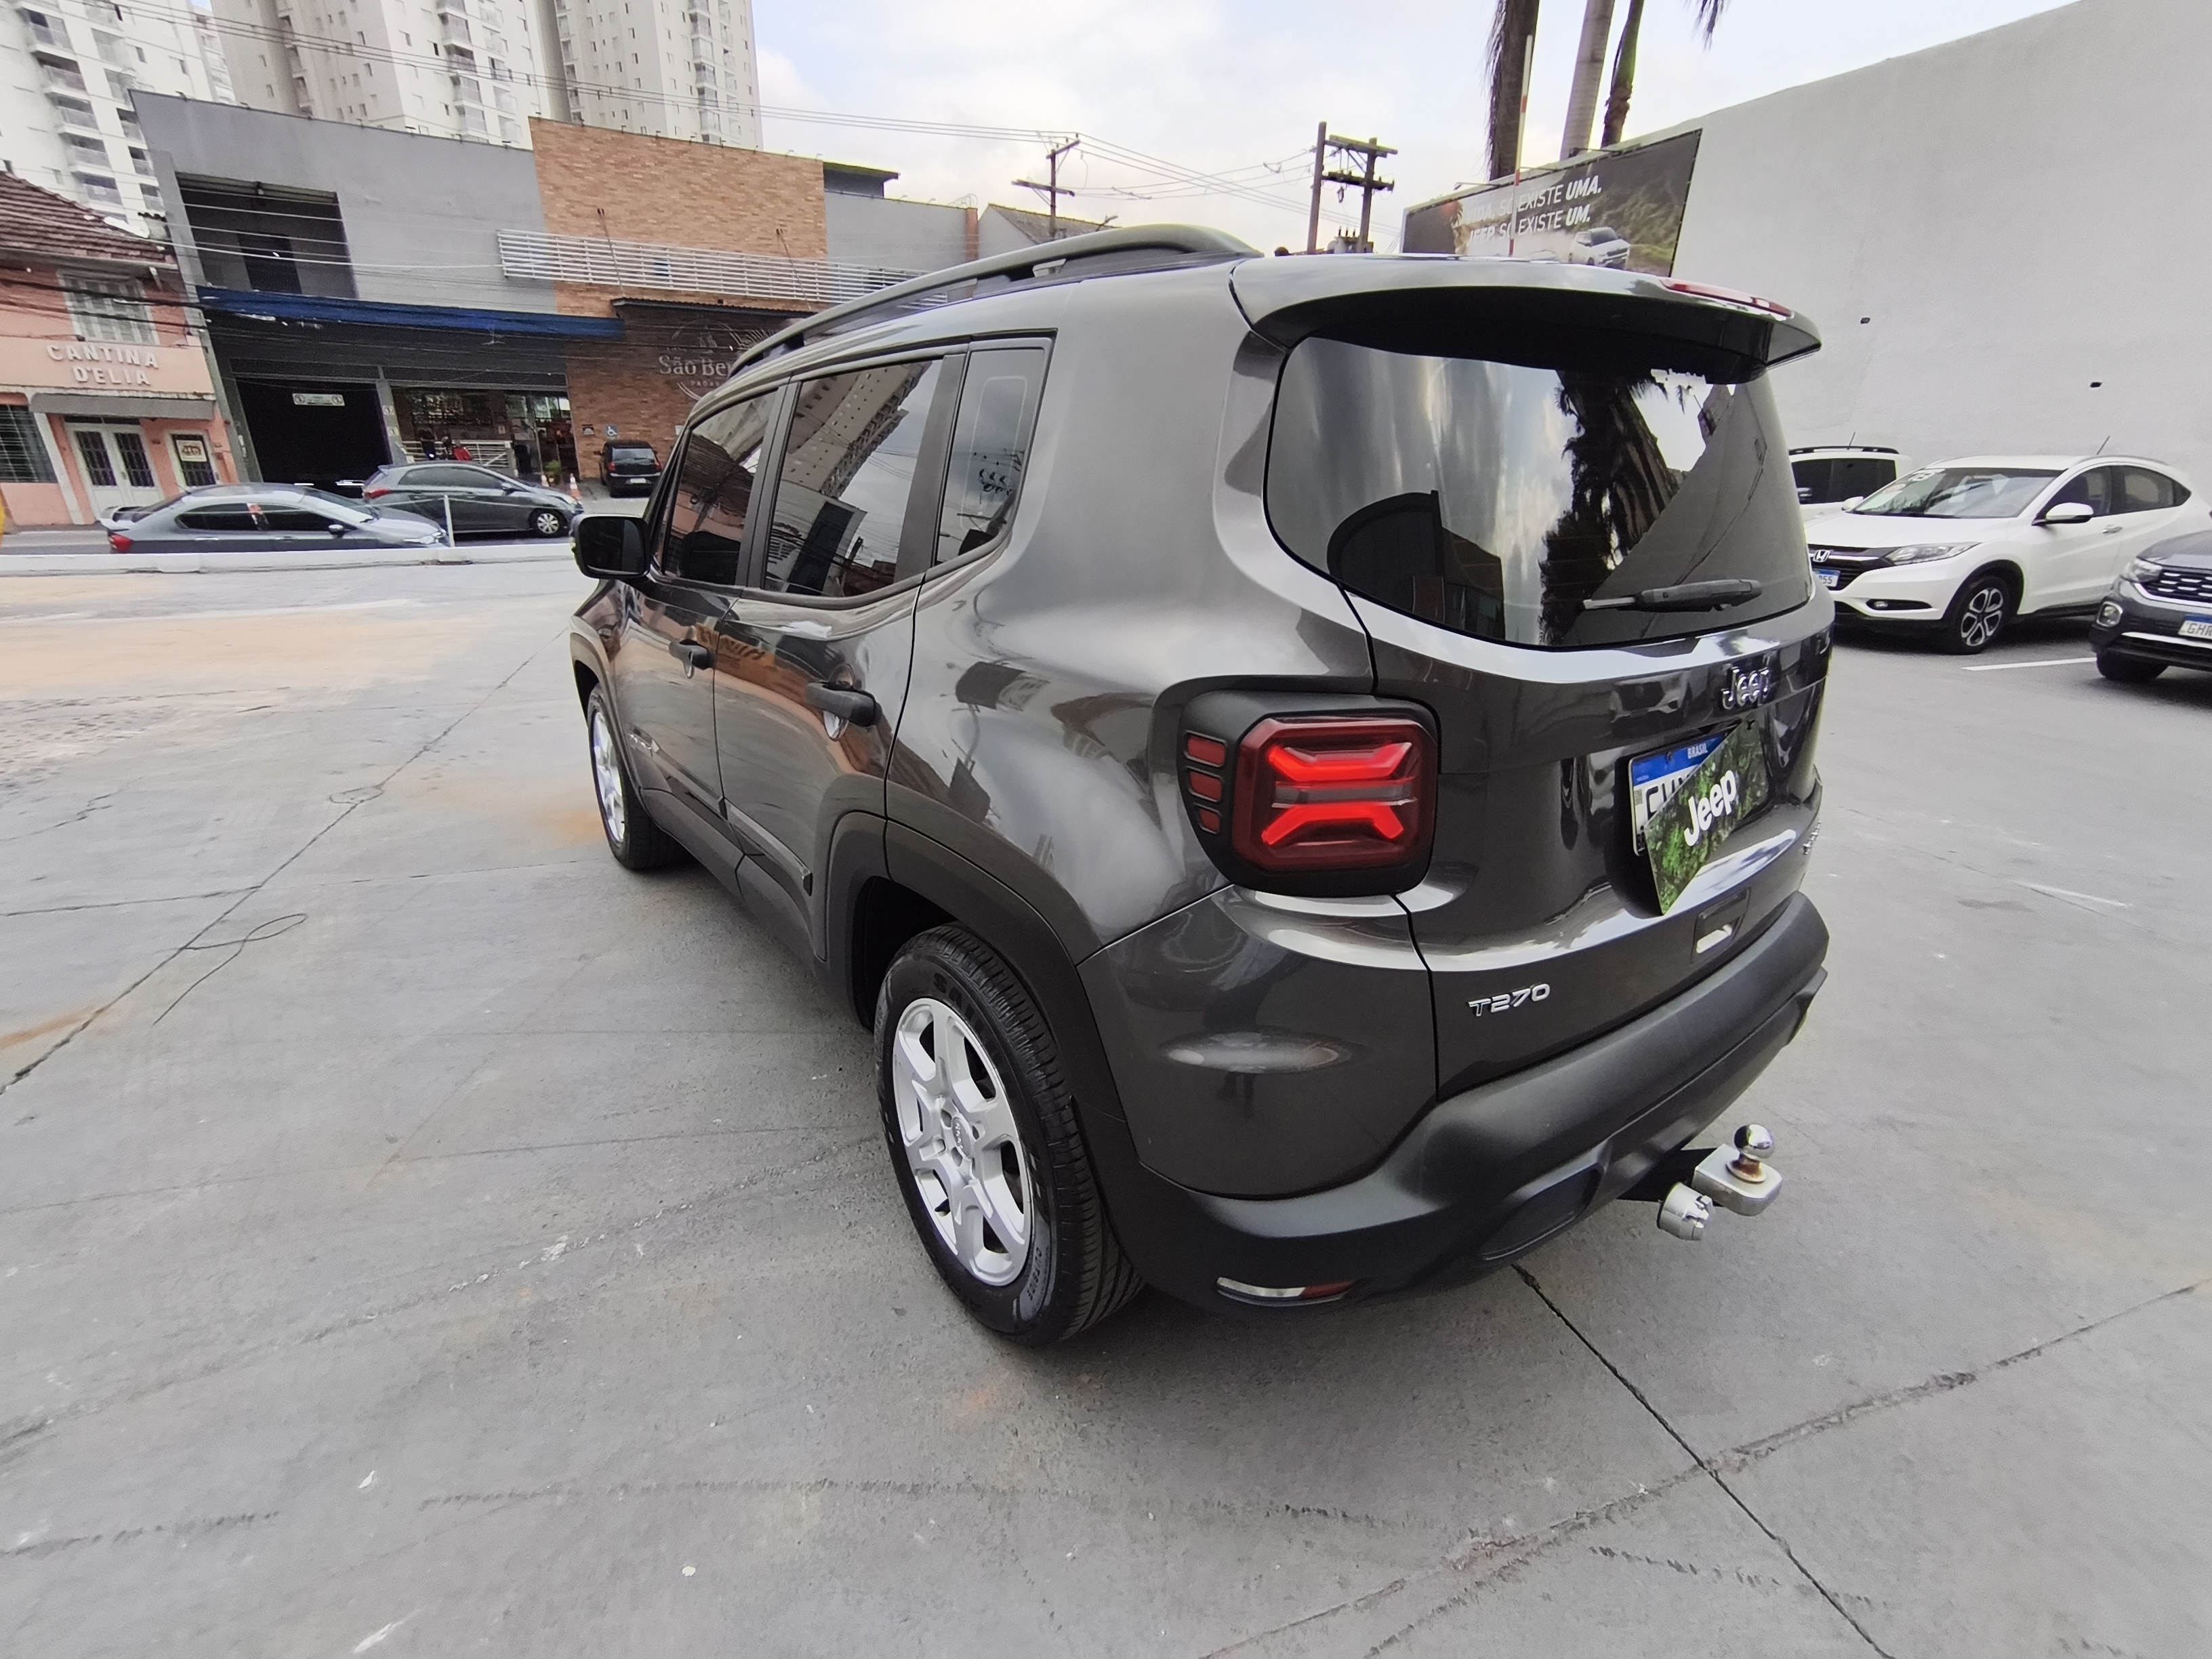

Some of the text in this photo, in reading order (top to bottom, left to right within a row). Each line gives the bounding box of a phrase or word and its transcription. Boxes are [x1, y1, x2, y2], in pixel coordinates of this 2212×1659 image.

[1517, 184, 1563, 212] EXISTE
[1565, 175, 1602, 201] UMA.
[1517, 210, 1563, 236] EXISTE
[1565, 204, 1591, 226] UM.
[47, 344, 159, 369] CANTINA
[659, 354, 697, 375] São
[73, 366, 151, 386] D'ELIA
[1721, 667, 1770, 710] Jeep
[1687, 743, 1708, 759] BRASIL
[1684, 770, 1736, 846] Jeep
[1468, 983, 1550, 1017] T270
